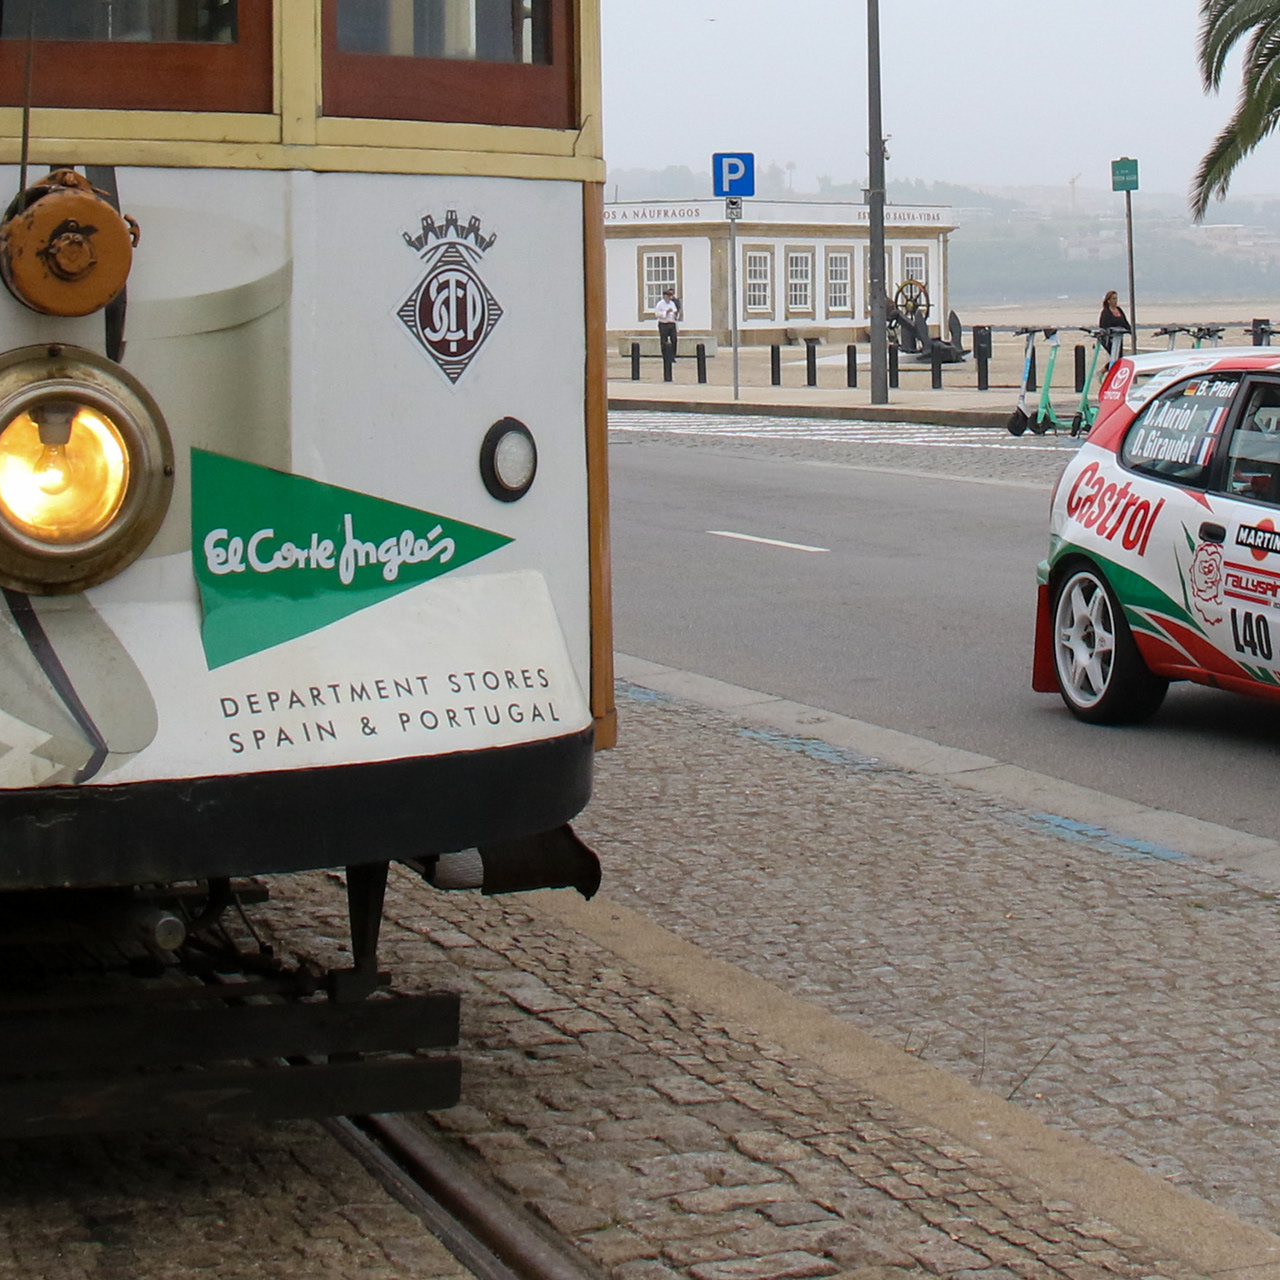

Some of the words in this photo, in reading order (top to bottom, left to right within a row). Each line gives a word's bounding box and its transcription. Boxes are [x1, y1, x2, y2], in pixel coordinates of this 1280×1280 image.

[722, 157, 746, 192] P
[621, 210, 628, 219] A
[633, 208, 700, 219] NÁUFRAGOS
[893, 212, 940, 221] SALVA-VIDAS
[1197, 380, 1208, 396] B.
[1208, 381, 1239, 398] Pfaff
[1067, 461, 1166, 557] Castrol
[204, 528, 246, 575] El
[247, 528, 336, 573] Corte
[339, 513, 456, 585] Inglés
[1231, 608, 1273, 661] L40
[220, 675, 429, 718] DEPARTMENT
[448, 668, 549, 694] STORES
[228, 720, 337, 754] SPAIN
[360, 716, 378, 736] &
[398, 702, 561, 732] PORTUGAL
